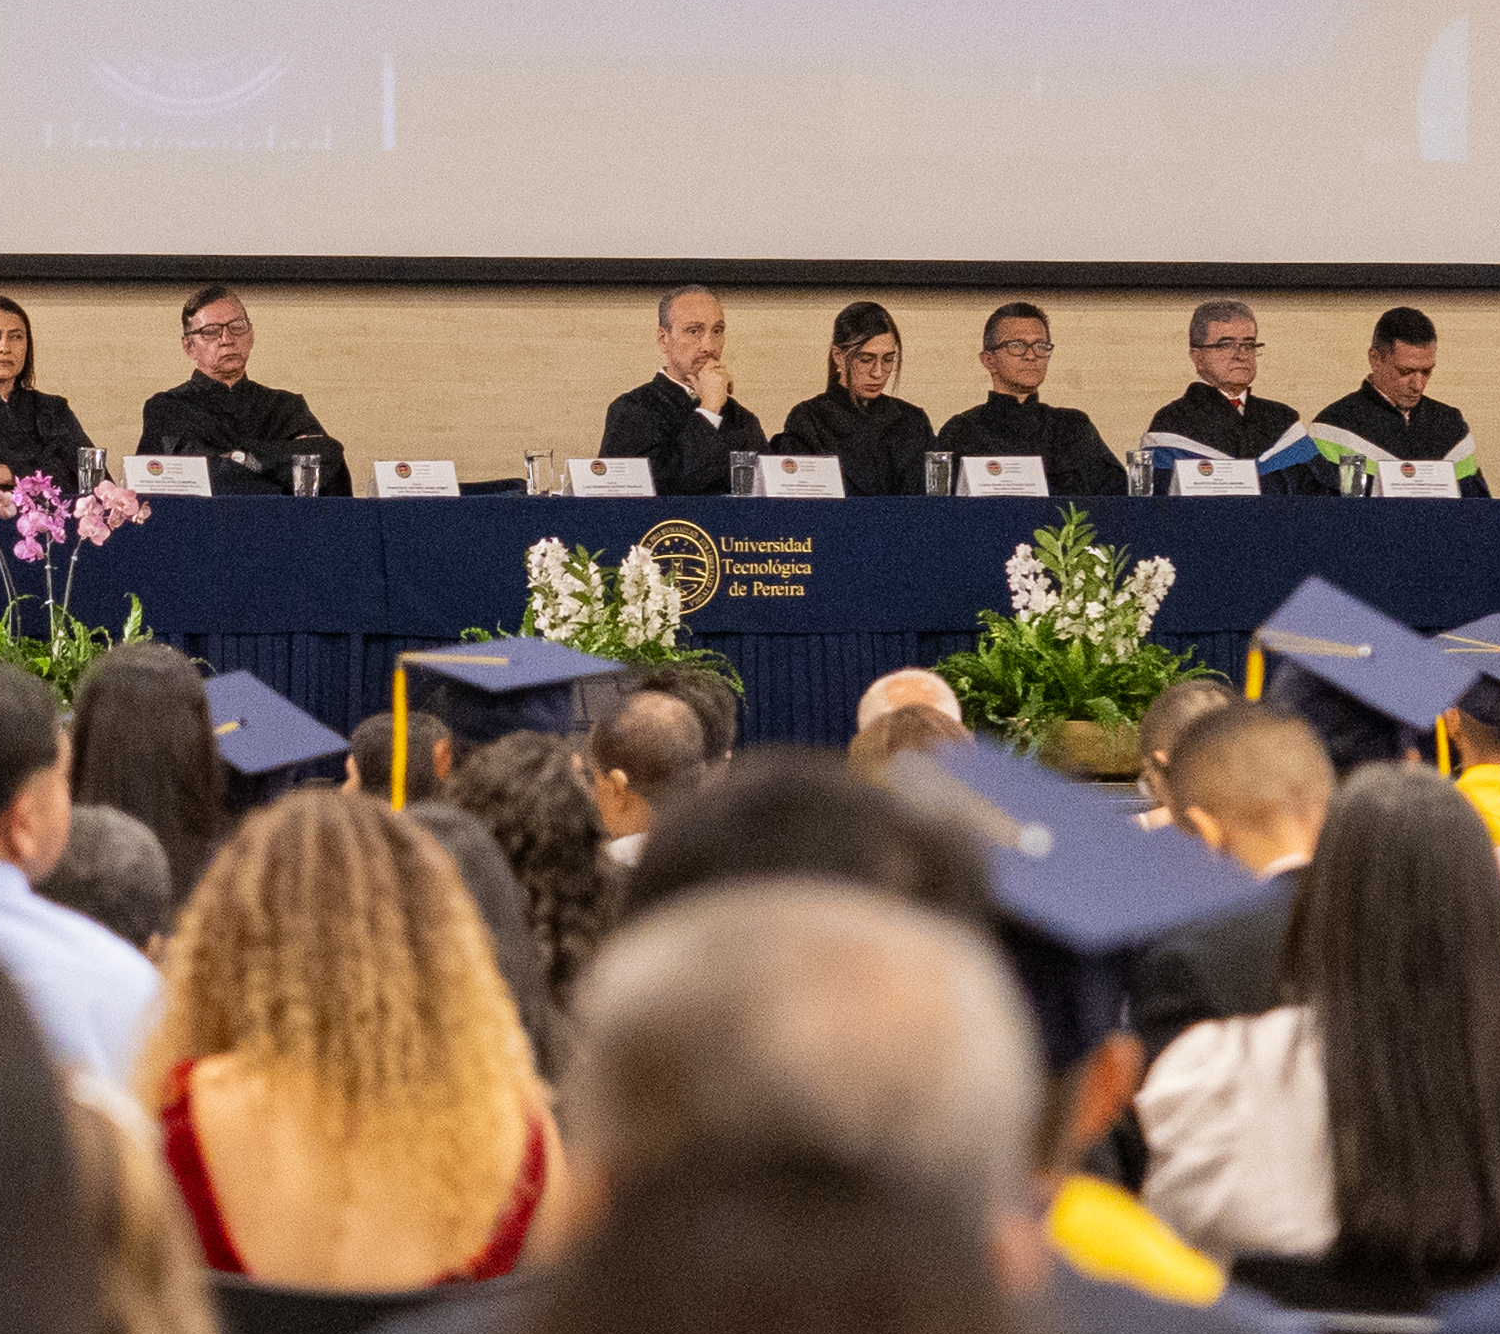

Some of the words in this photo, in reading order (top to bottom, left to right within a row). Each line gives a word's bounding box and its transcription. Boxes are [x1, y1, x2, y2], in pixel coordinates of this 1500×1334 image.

[720, 536, 812, 553] Universidad
[721, 558, 812, 578] Tecnológica
[729, 581, 748, 597] de
[753, 581, 805, 597] Pereira
